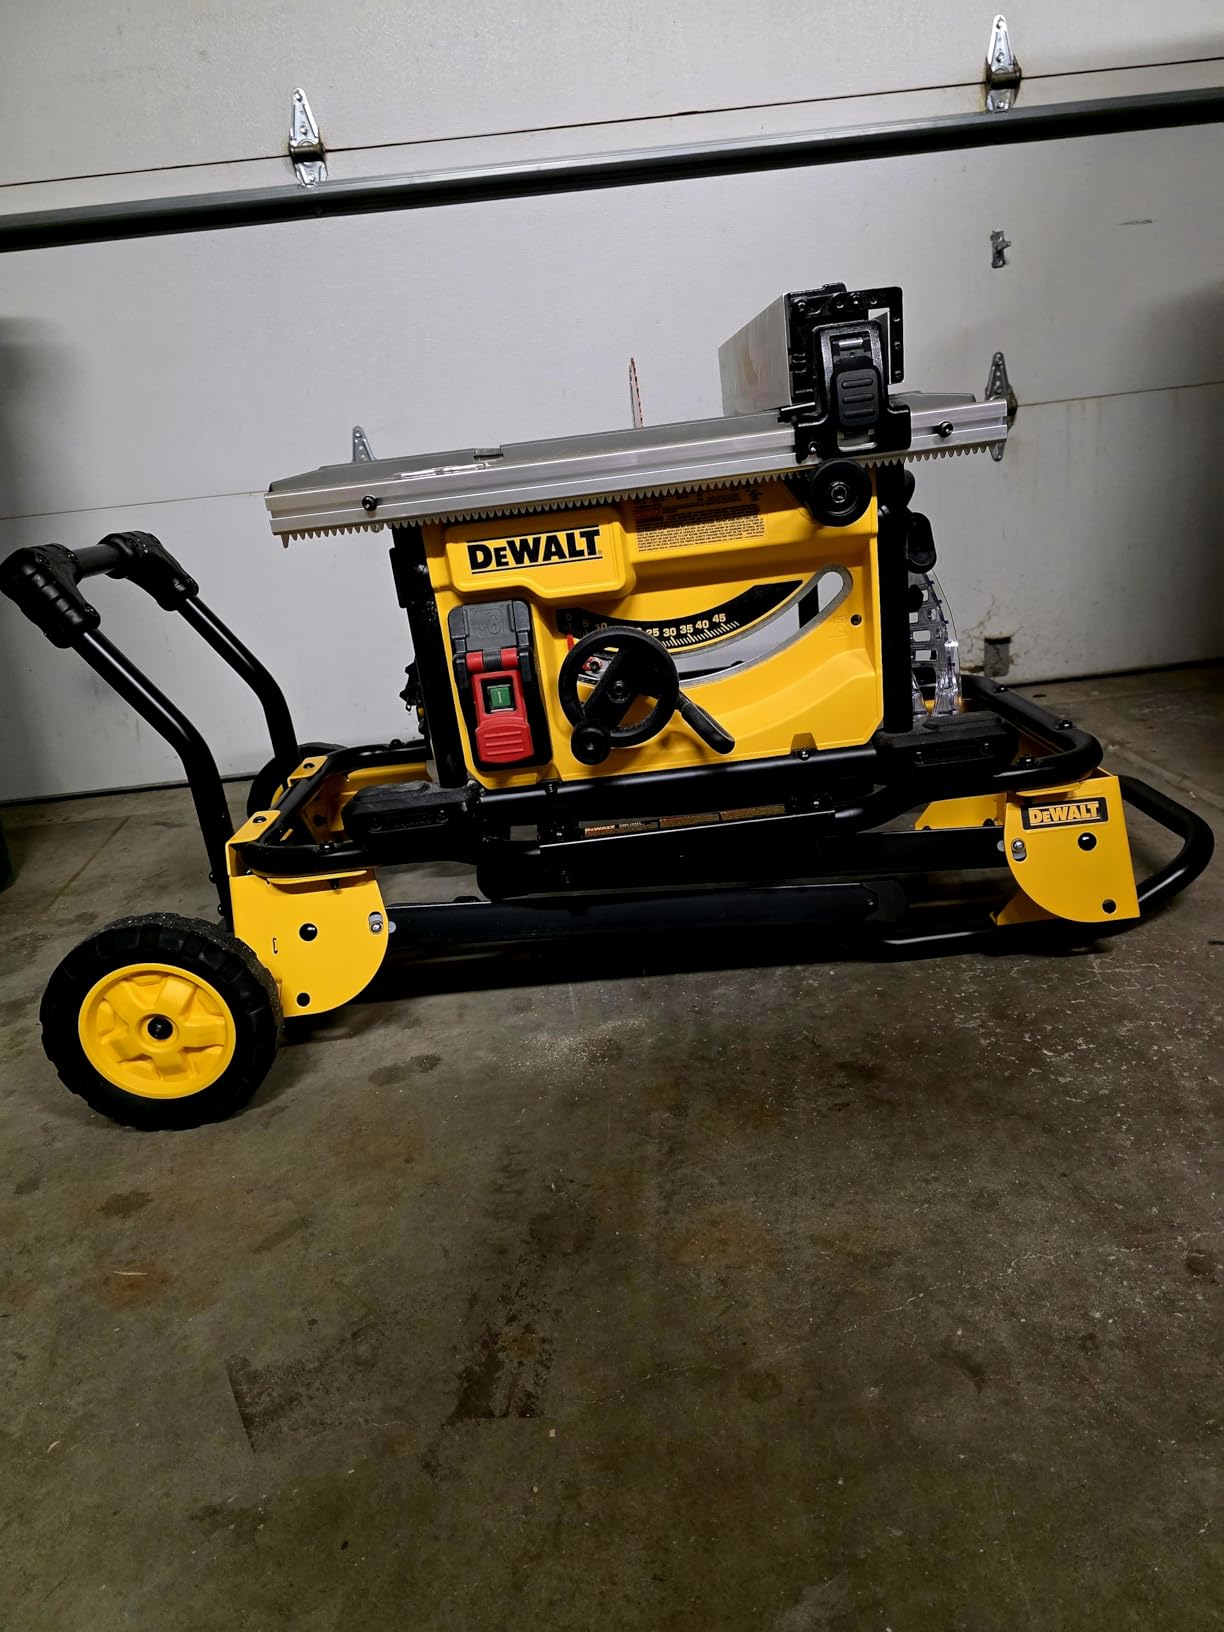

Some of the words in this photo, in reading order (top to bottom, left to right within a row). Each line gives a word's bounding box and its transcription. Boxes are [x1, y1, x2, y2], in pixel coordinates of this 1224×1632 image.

[663, 627, 677, 637] 30
[679, 624, 694, 634] 35
[695, 620, 709, 629] 40
[712, 613, 726, 623] 45
